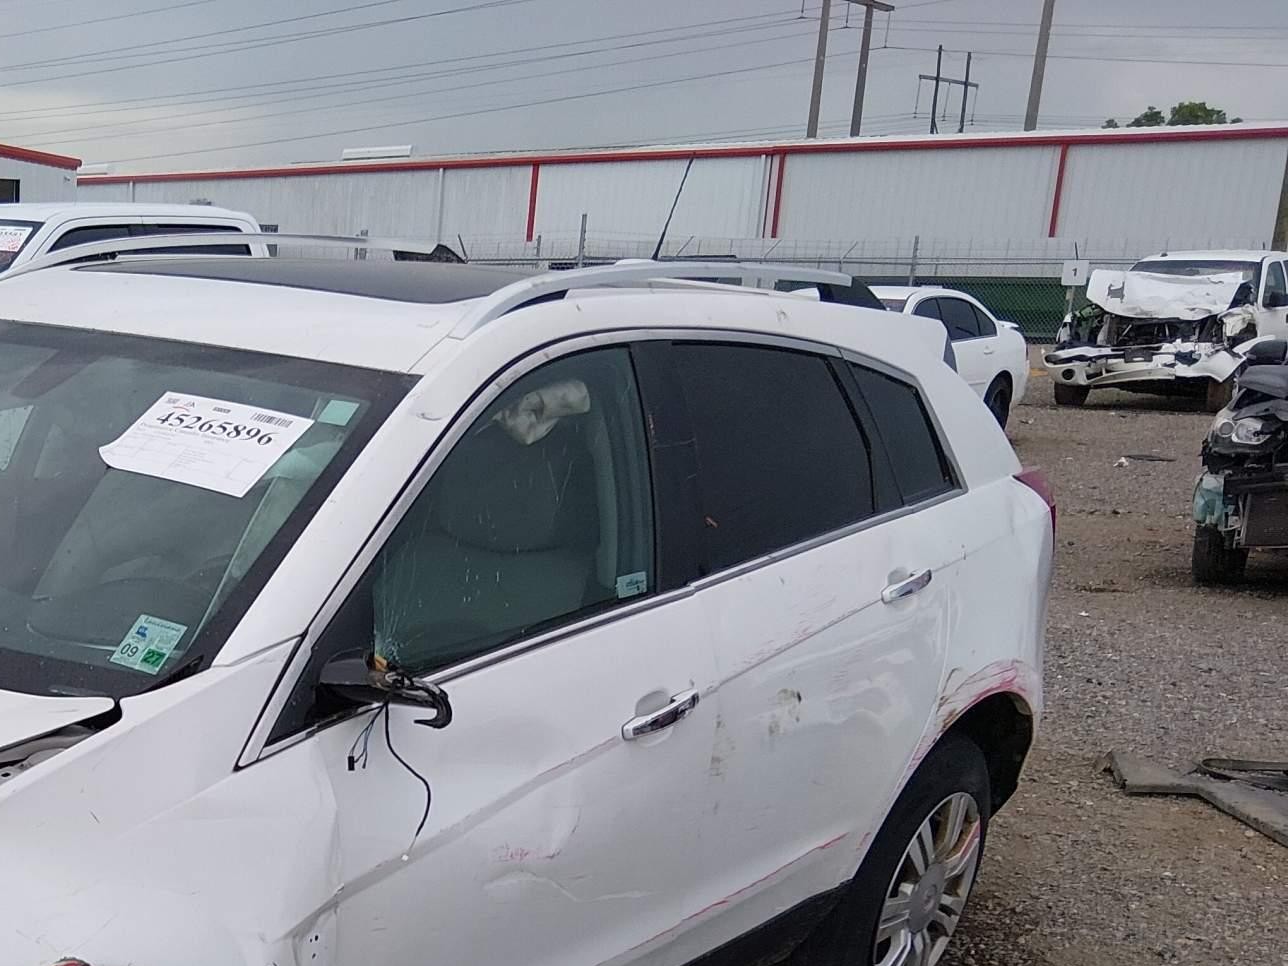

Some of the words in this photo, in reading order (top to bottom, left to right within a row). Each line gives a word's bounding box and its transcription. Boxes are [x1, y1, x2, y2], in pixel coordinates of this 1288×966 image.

[1071, 267, 1078, 277] 1
[156, 411, 277, 446] 45265896
[120, 643, 139, 658] 09
[142, 649, 166, 665] 27
